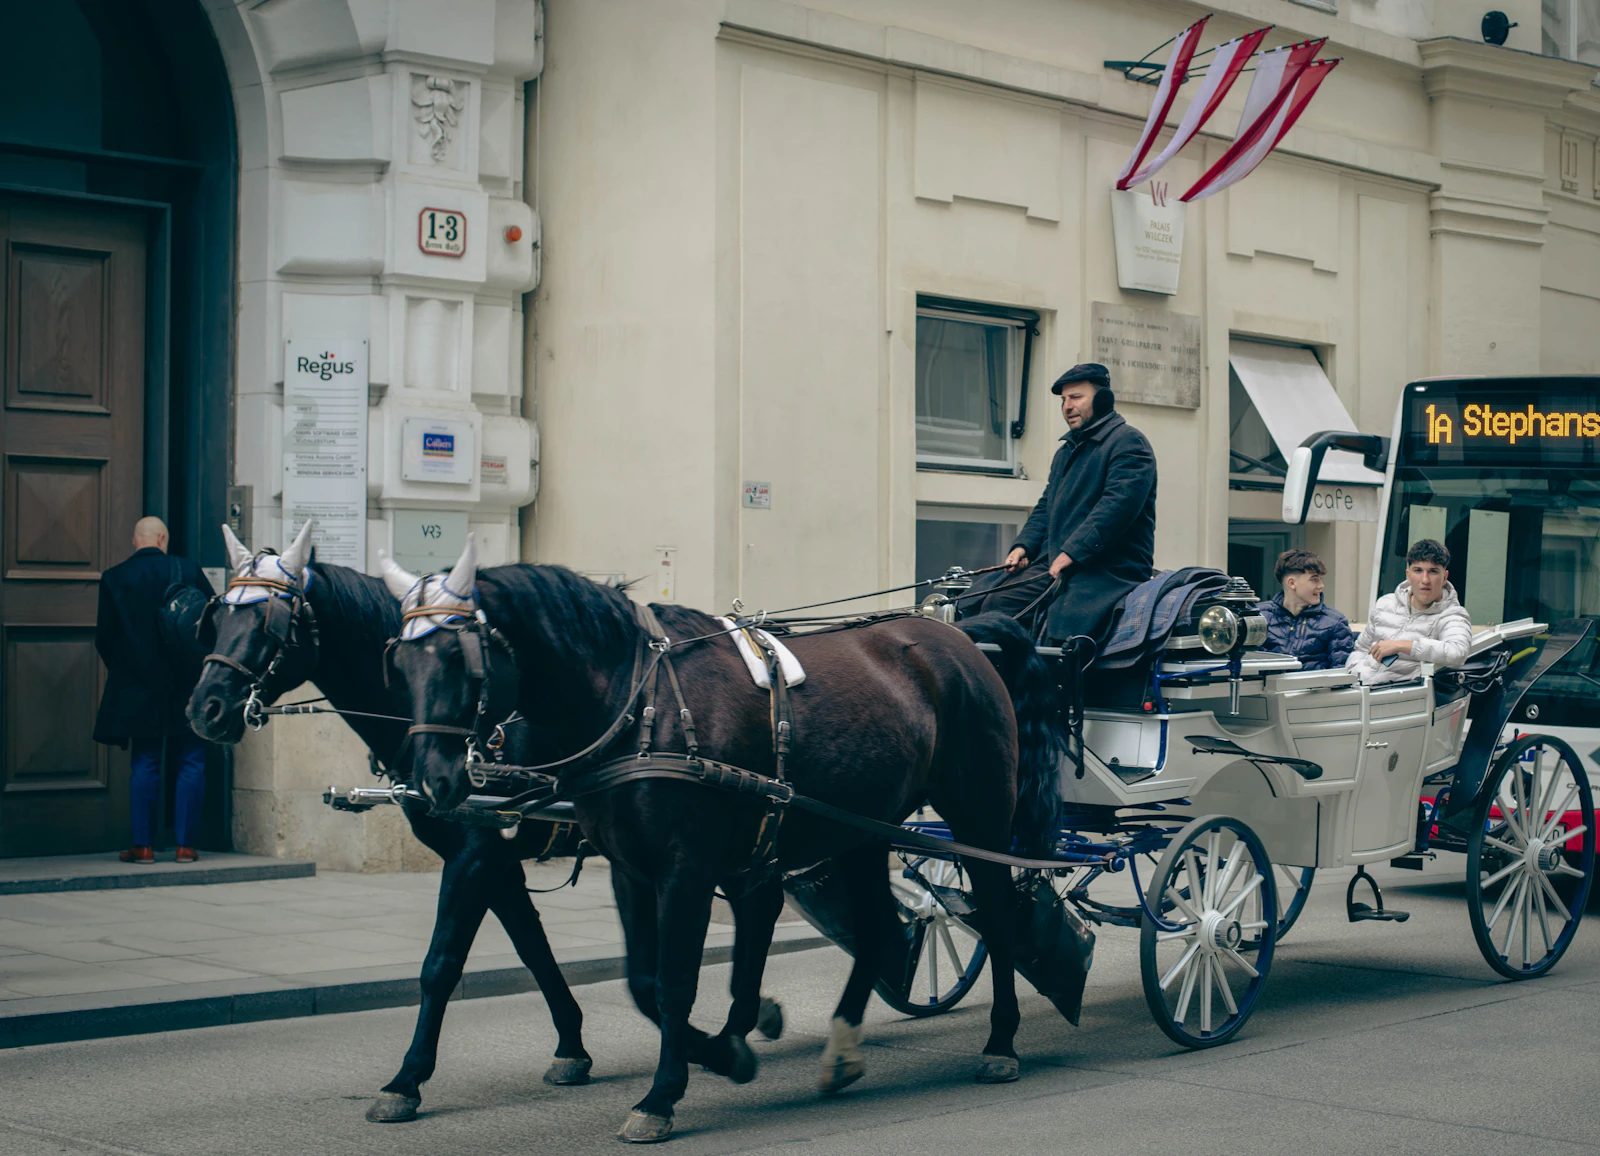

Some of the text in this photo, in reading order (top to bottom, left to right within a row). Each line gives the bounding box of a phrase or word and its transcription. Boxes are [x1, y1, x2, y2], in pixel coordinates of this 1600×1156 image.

[428, 212, 457, 241] 1-3
[1149, 220, 1170, 232] PALAIS
[1145, 231, 1173, 244] WILCZEK
[297, 356, 354, 381] Regus
[1425, 404, 1600, 444] 1A Stephans
[425, 437, 452, 449] Colliers
[1314, 488, 1353, 510] cafe
